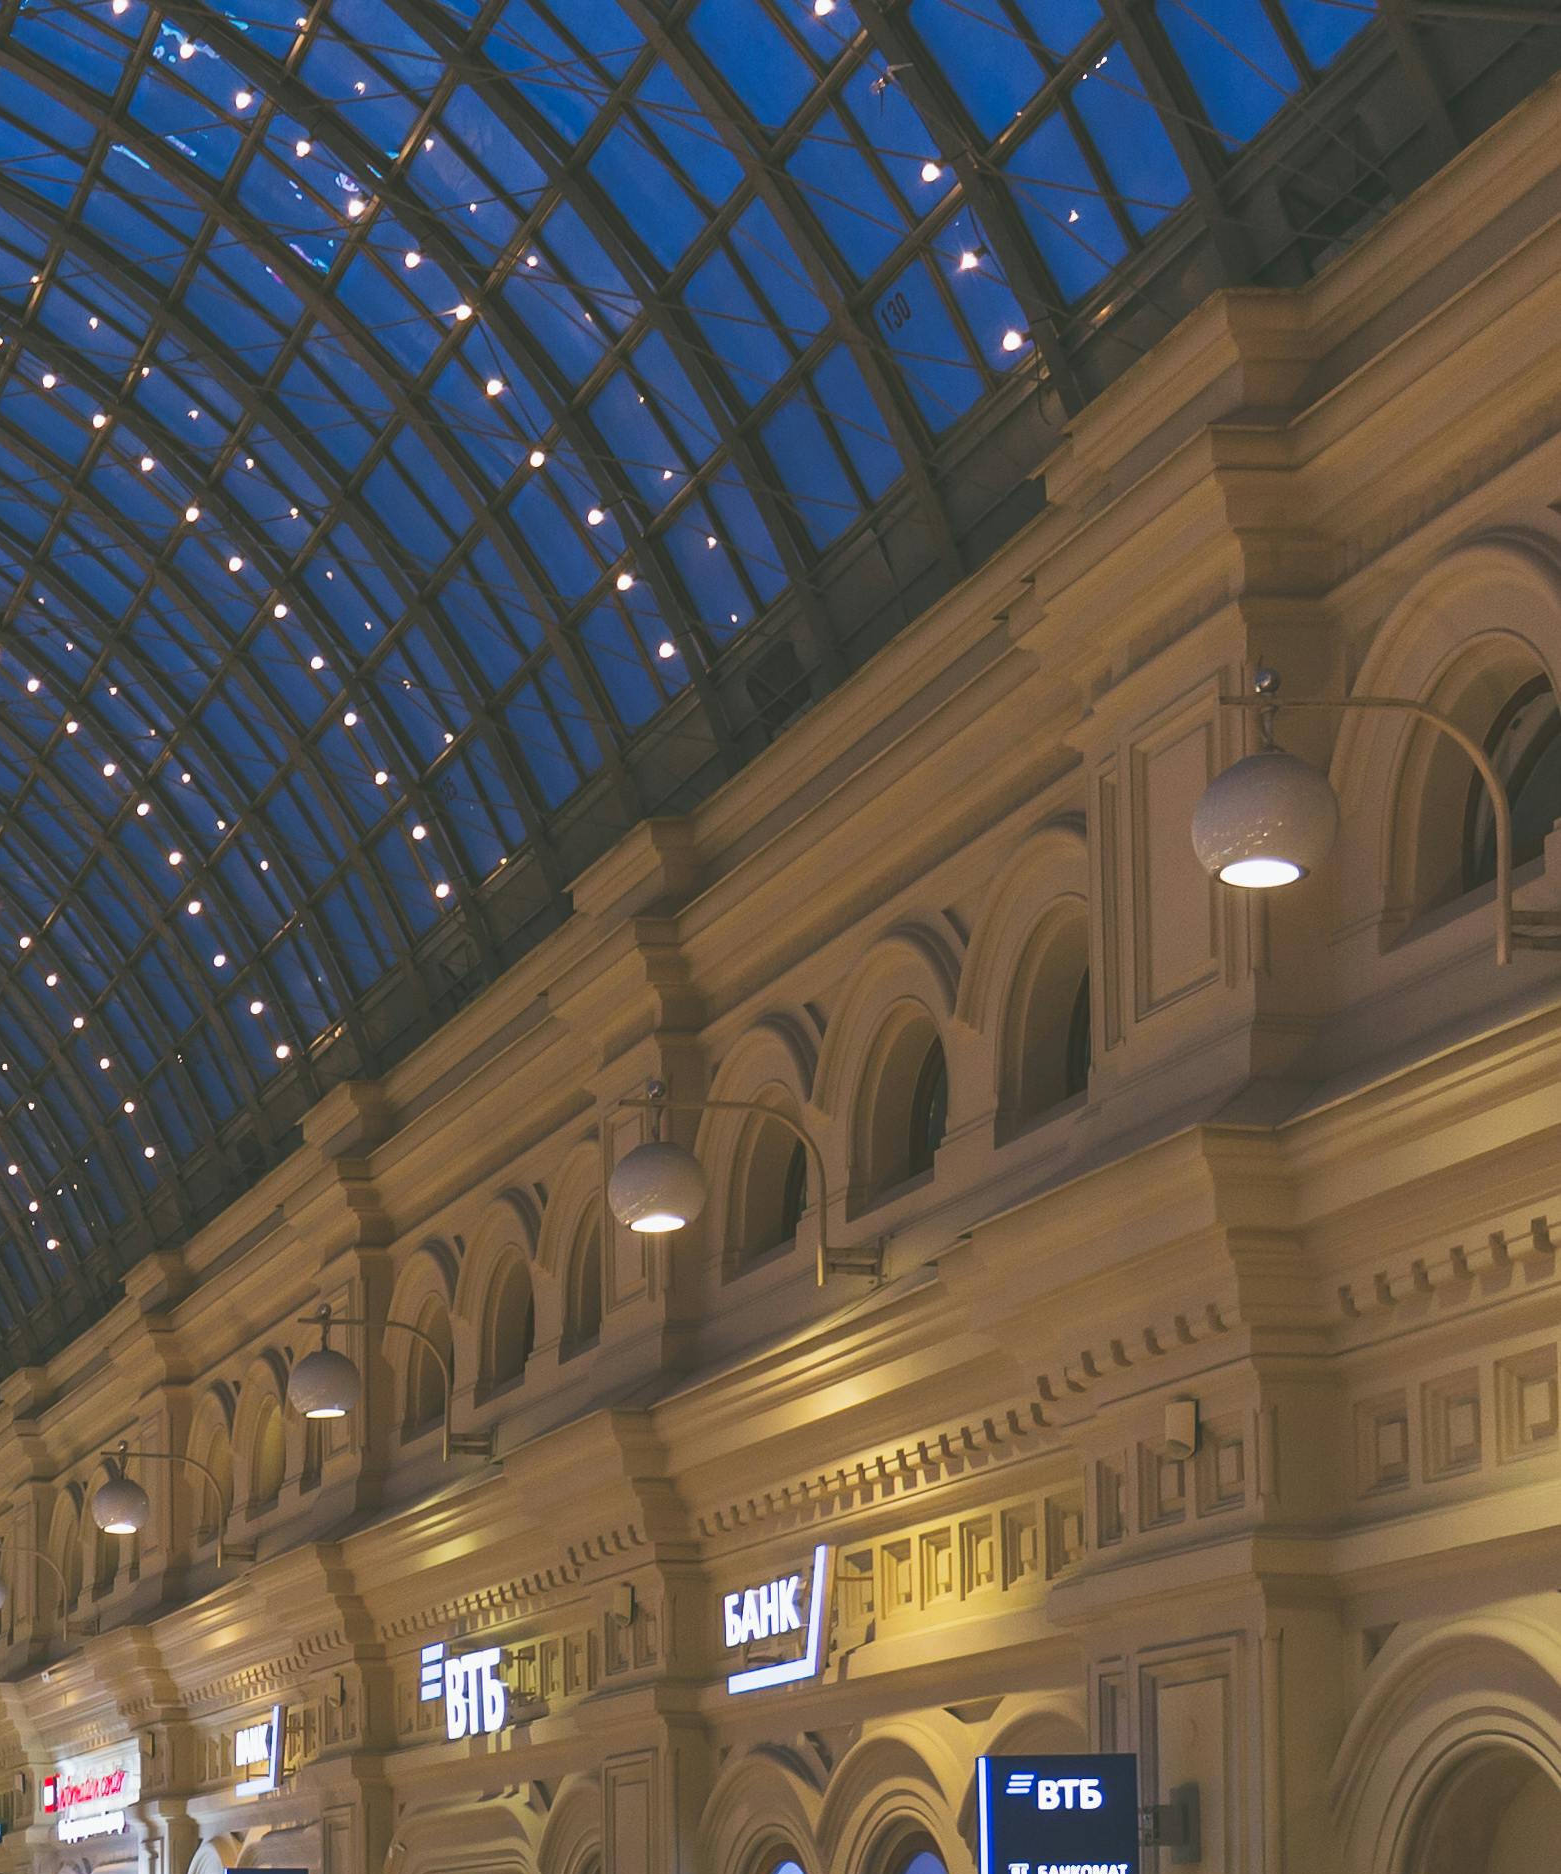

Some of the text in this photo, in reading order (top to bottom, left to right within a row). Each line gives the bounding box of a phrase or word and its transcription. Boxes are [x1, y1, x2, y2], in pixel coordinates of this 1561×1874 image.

[724, 1575, 801, 1648] БАНК
[444, 1647, 506, 1740] ВТБ
[1037, 1778, 1103, 1810] ВТБ
